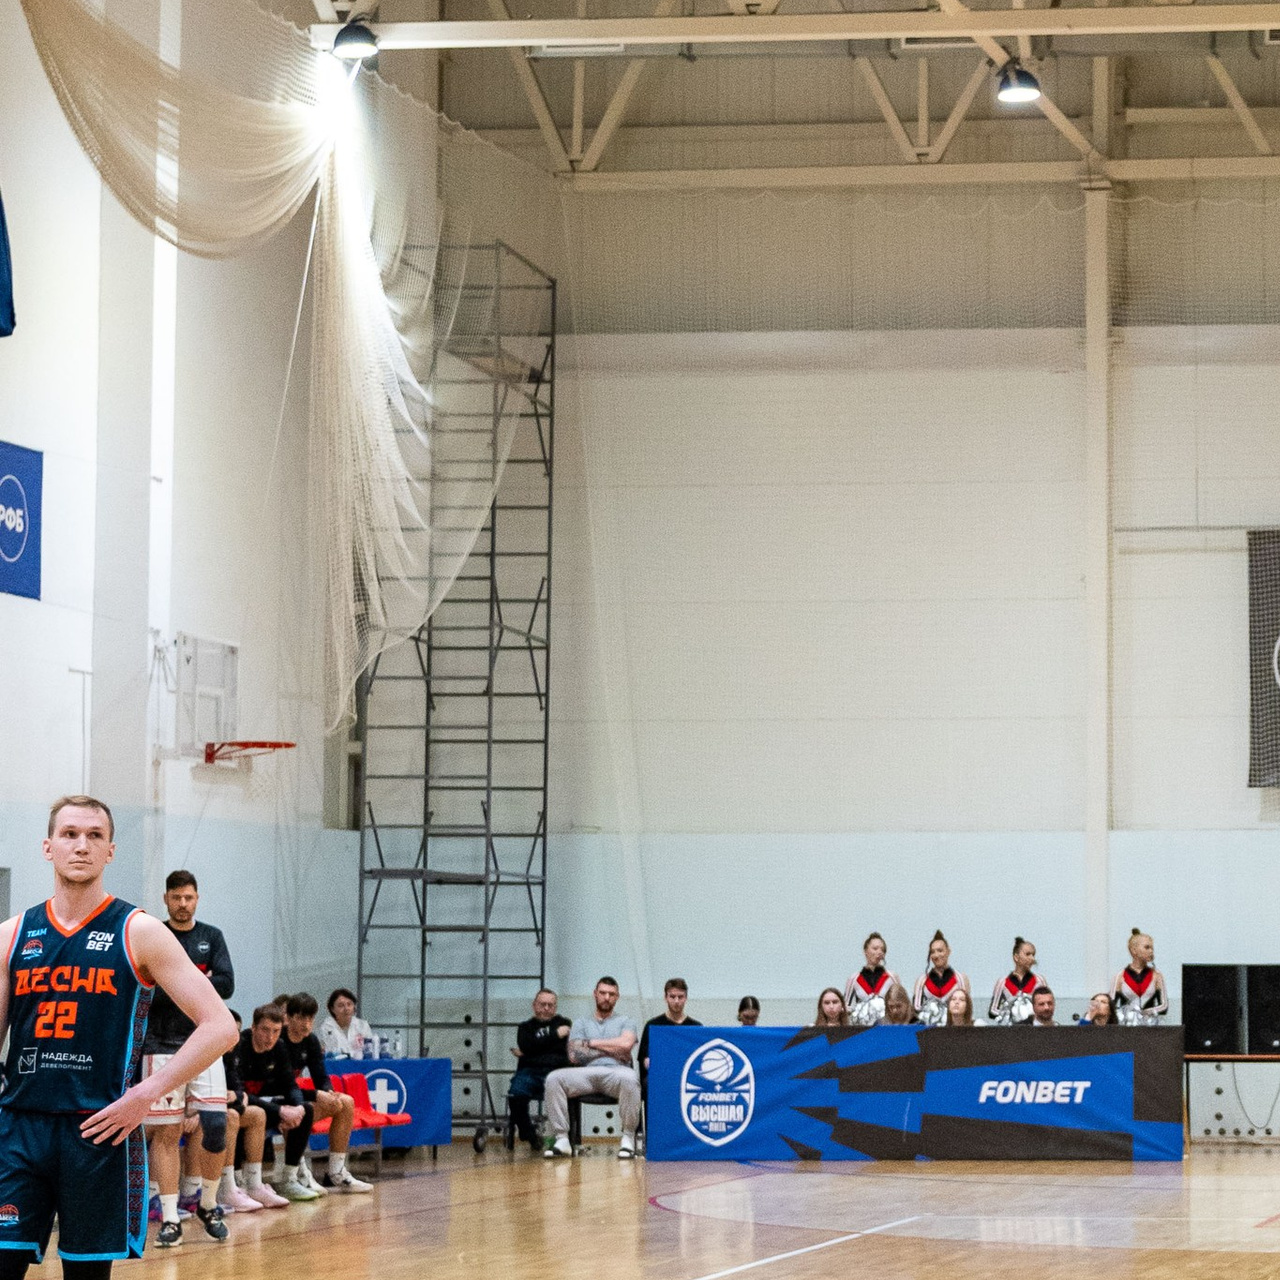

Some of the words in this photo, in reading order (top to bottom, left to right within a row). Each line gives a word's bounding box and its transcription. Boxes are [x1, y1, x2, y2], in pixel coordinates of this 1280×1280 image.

[27, 928, 47, 938] TEAM
[88, 930, 115, 942] FON
[86, 941, 113, 952] BET
[15, 965, 118, 996] ДЕСНА
[34, 1001, 78, 1039] 22
[41, 1052, 93, 1063] НАДЕЖДА
[699, 1092, 739, 1102] FONBET
[979, 1080, 1092, 1104] FONBET
[691, 1105, 744, 1122] ВЫСШАЯ
